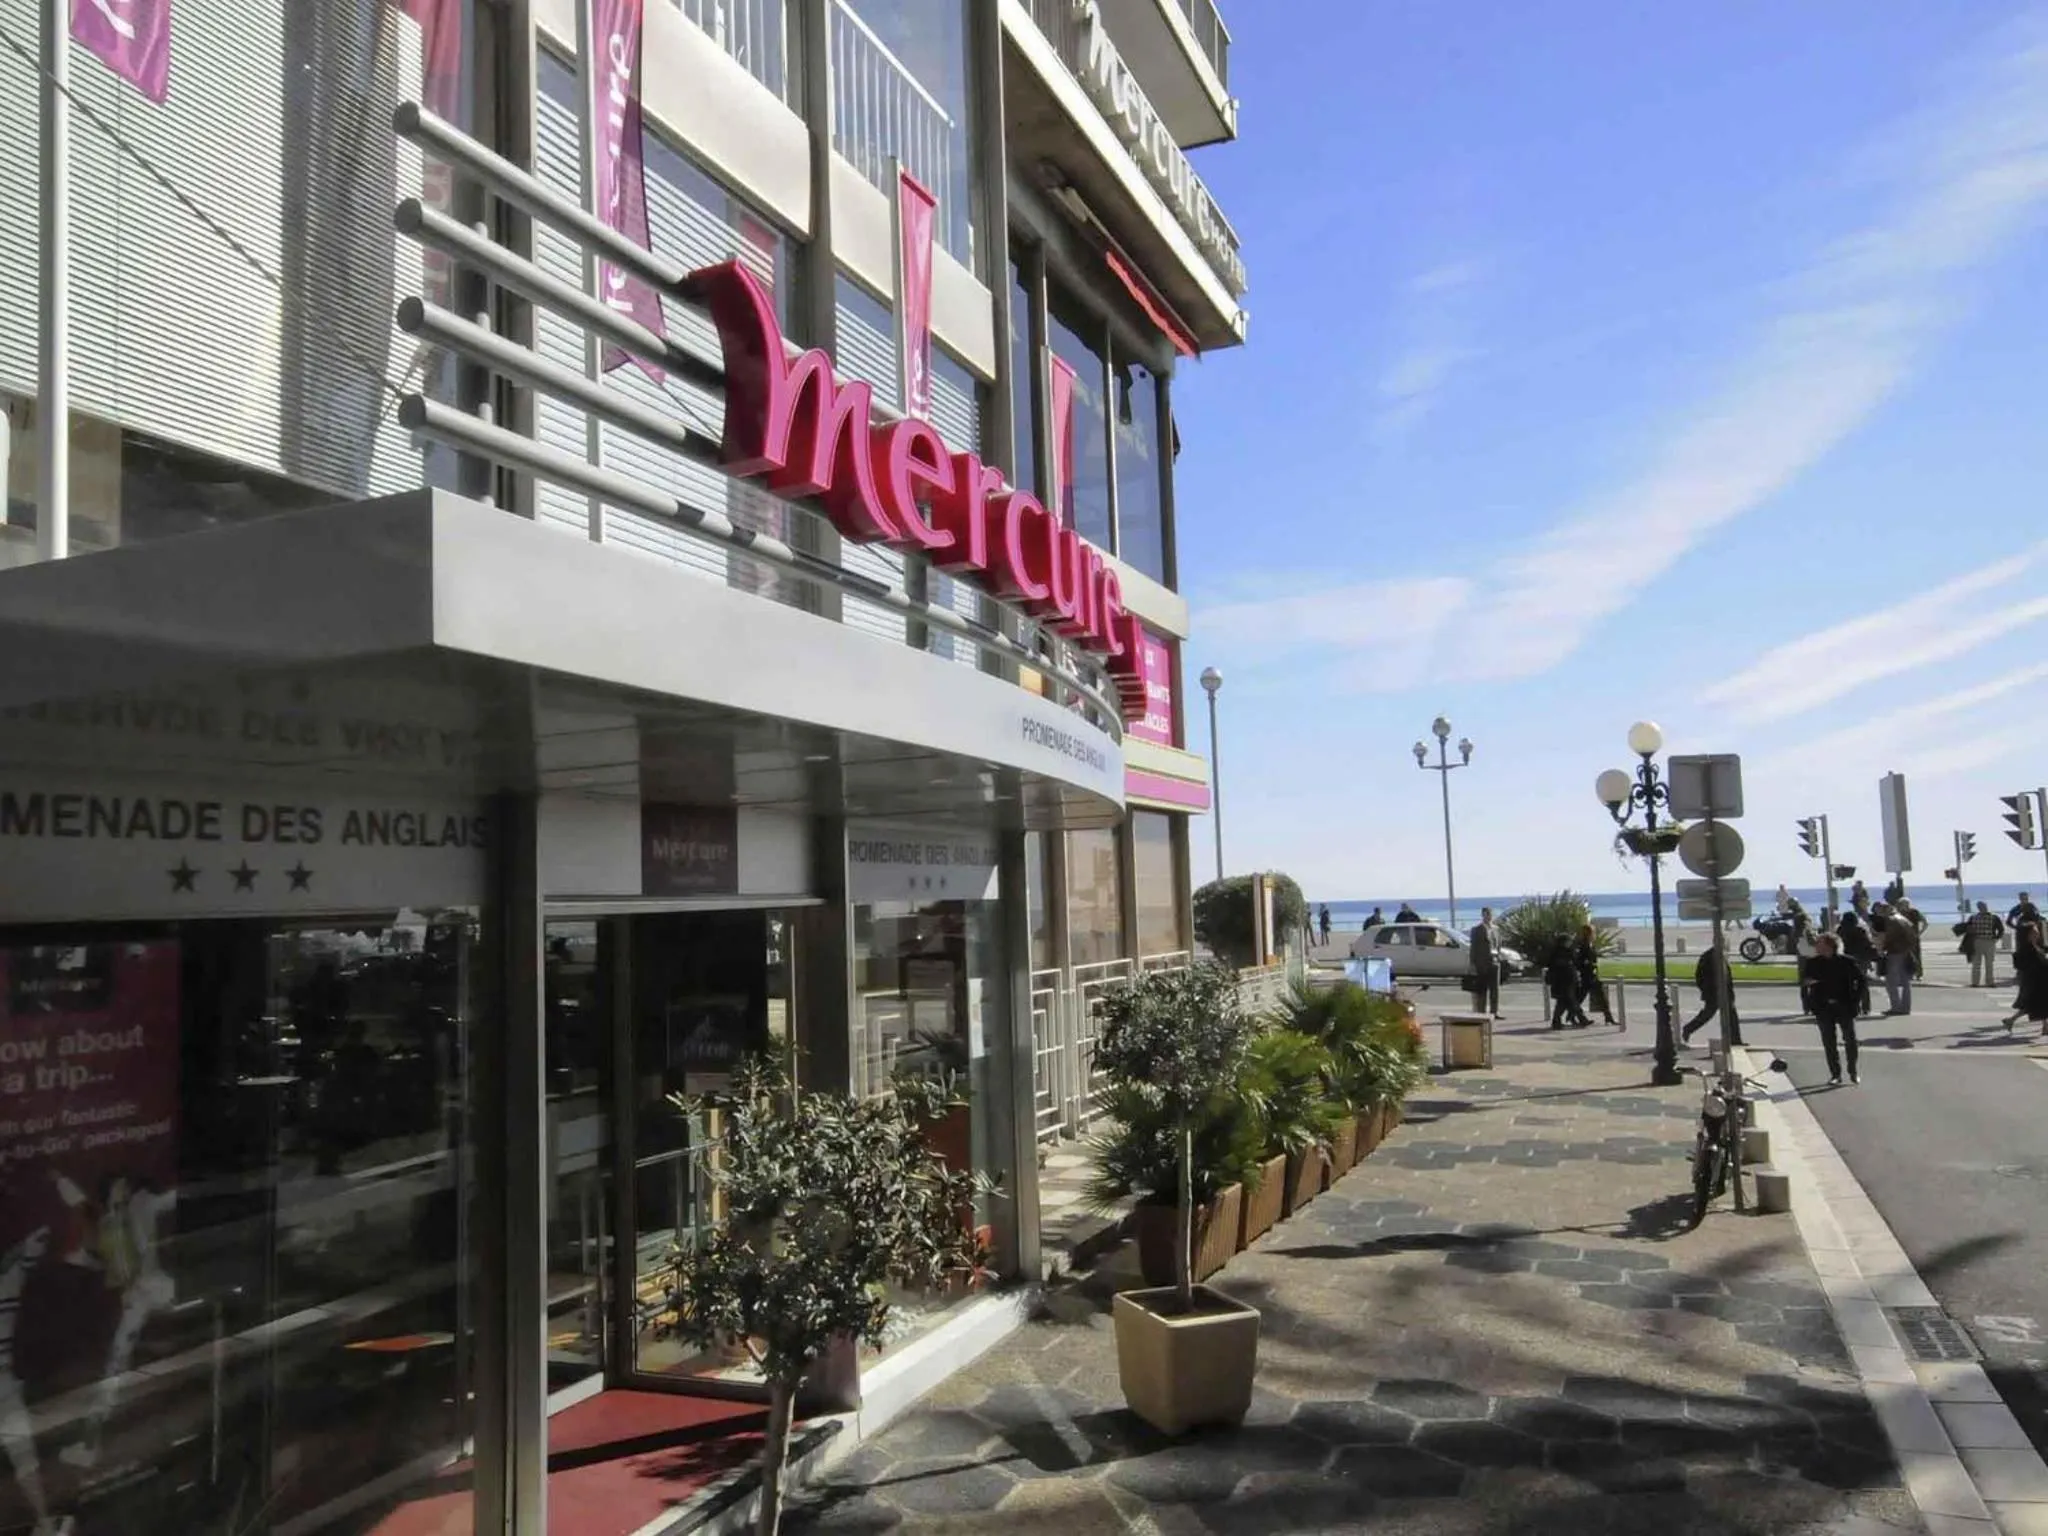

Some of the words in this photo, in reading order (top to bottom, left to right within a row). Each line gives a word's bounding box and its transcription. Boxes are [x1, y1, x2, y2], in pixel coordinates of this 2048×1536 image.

[241, 805, 324, 844] DES
[341, 810, 491, 849] ANGLAIS
[59, 1024, 143, 1056] about
[35, 1060, 113, 1091] trip...
